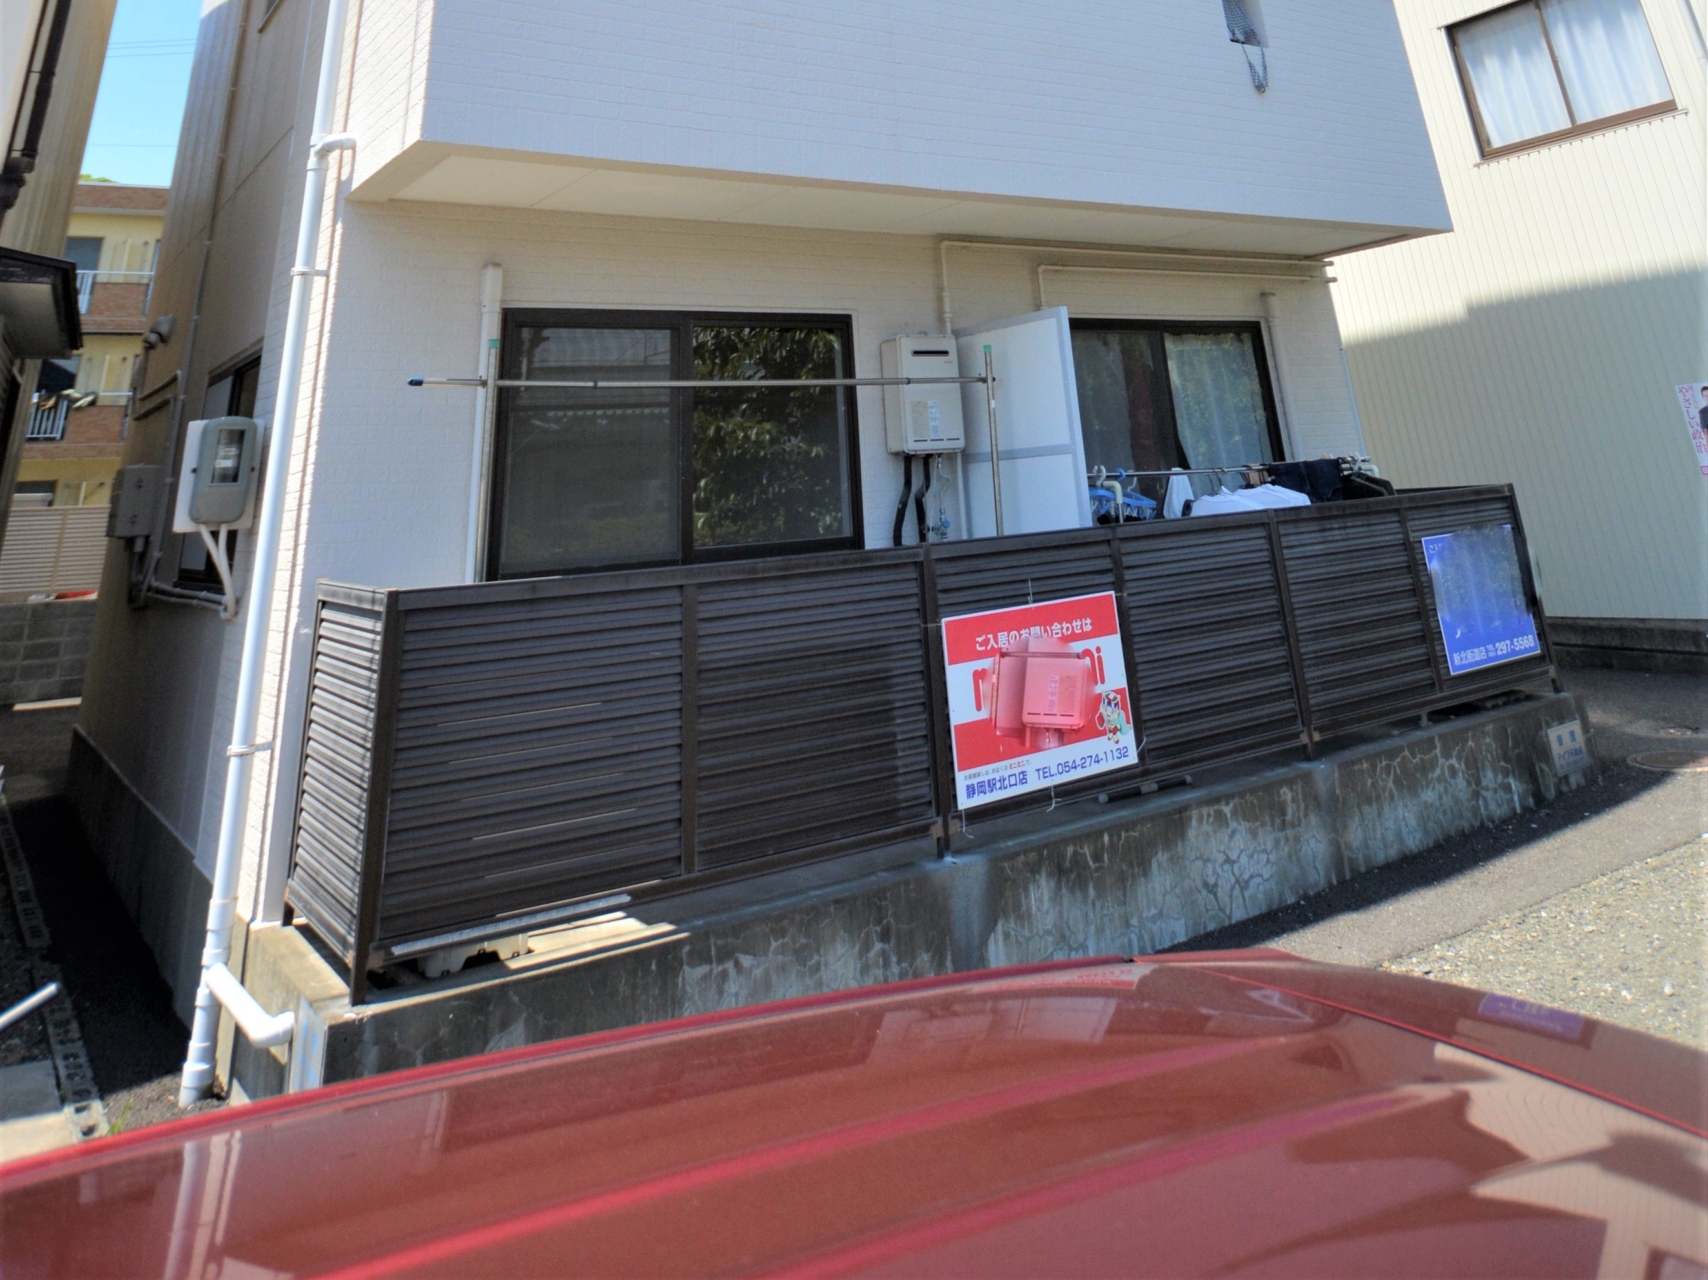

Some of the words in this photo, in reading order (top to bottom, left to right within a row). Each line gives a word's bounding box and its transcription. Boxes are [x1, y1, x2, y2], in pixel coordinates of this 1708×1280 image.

[1496, 634, 1535, 655] 297-5568
[965, 770, 1028, 800] 静岡駅北口店
